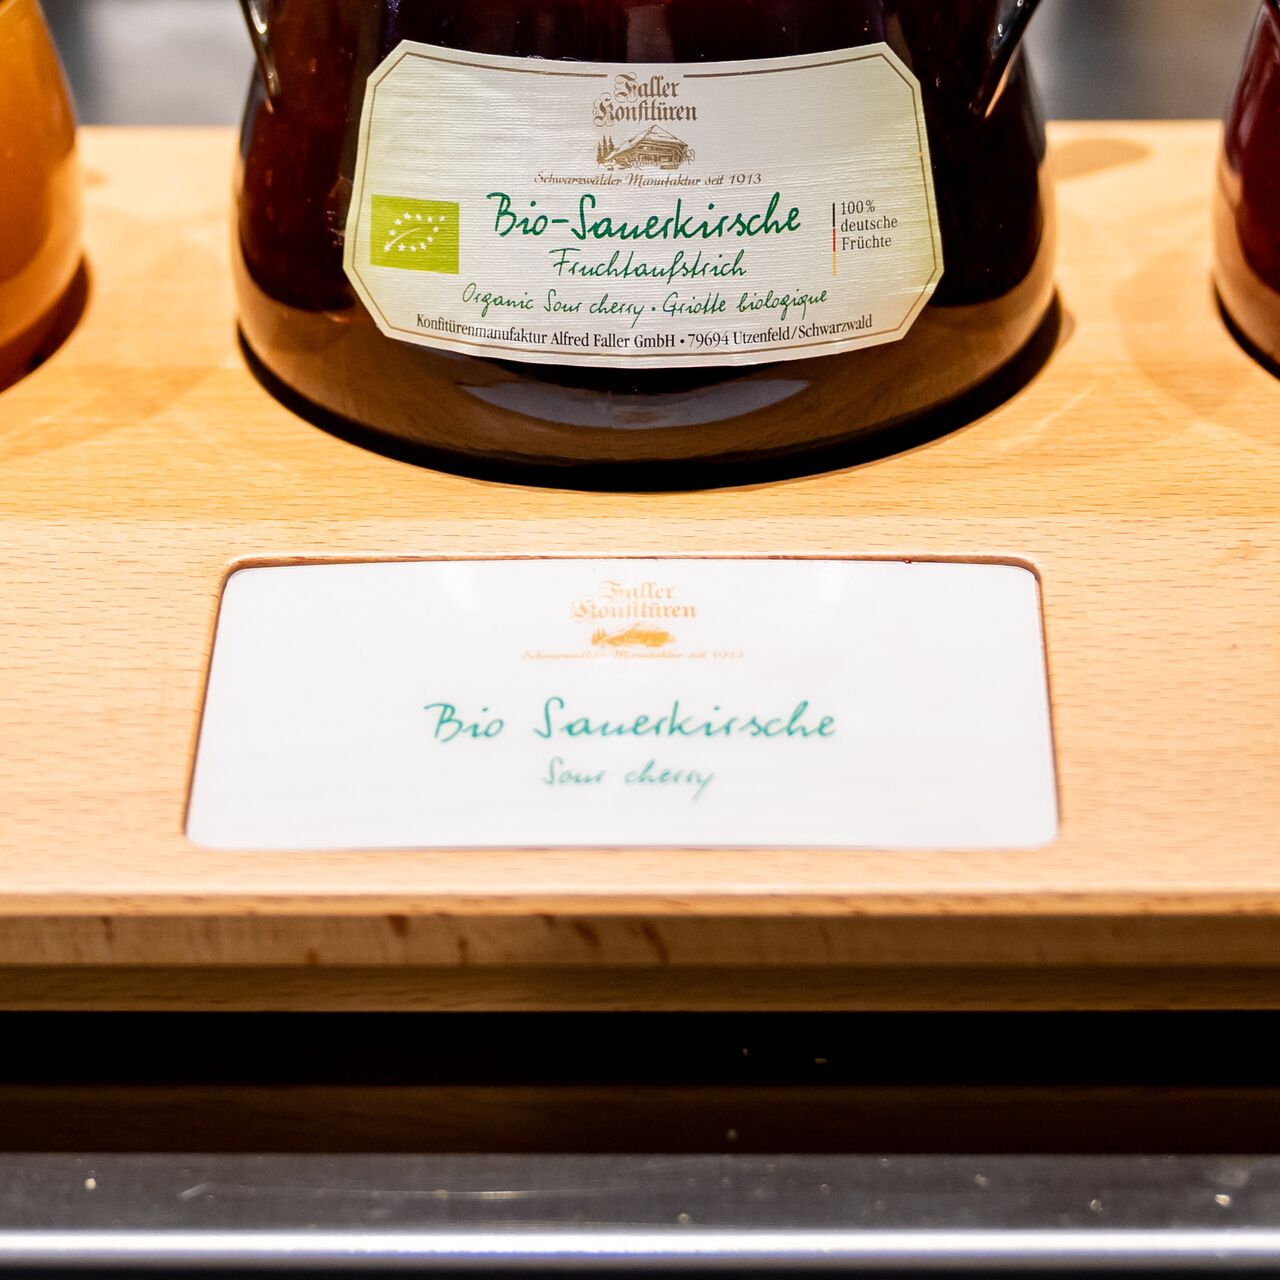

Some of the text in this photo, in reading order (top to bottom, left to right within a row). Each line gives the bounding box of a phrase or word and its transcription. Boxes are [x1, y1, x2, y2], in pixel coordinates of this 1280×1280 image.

[615, 72, 680, 102] Faller
[593, 93, 698, 126] Konfitüren
[534, 170, 762, 187] Schwarzwälder Manufaktur seit 1913
[486, 191, 801, 242] Bio-Sauerkirsche
[841, 199, 876, 215] 100%
[840, 214, 899, 233] deutsche
[841, 232, 893, 251] Früchte
[549, 247, 747, 285] Fruchtaufstrich
[462, 282, 828, 329] Organic Sour cherry Griotte biologique
[416, 313, 873, 350] Konfitürenmanufaktur Alfred Faller GmbH 79694 Utzenfeld/Schwarzwald
[600, 579, 675, 601] Faller
[571, 596, 698, 623] Konfitüren
[423, 696, 836, 742] Bio Sauerkirsche
[542, 755, 716, 802] Sour cherry
